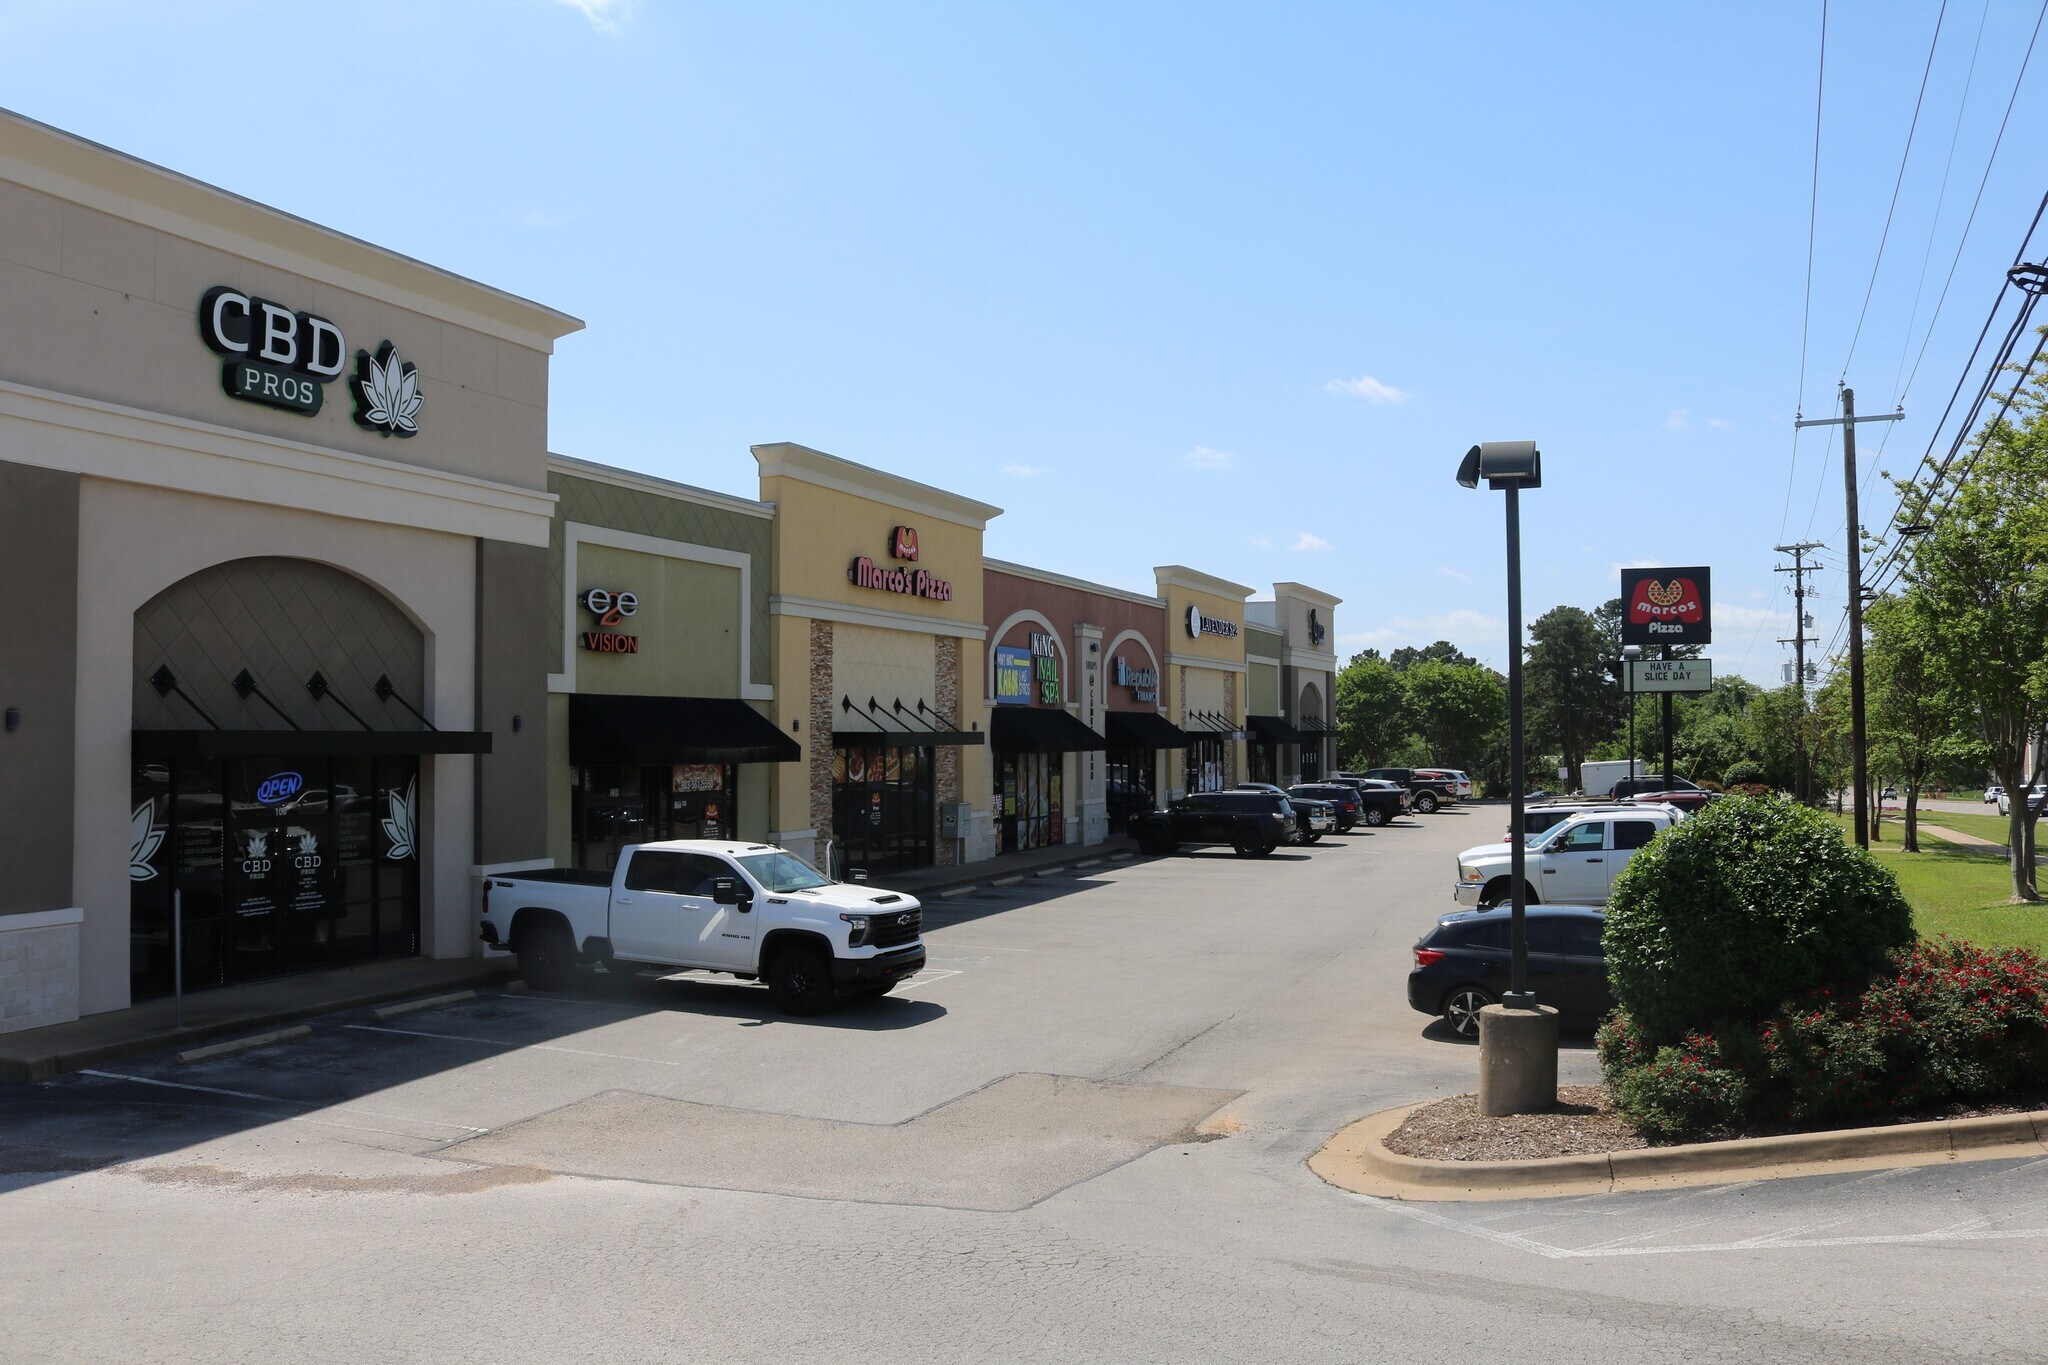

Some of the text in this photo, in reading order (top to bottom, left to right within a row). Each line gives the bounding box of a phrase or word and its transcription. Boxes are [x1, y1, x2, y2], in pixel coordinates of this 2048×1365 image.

[212, 291, 347, 377] CBD
[244, 367, 314, 404] PROS
[857, 556, 952, 601] Marco's Pizza
[1202, 616, 1230, 636] LAVENDER
[1648, 621, 1684, 634] Pizza
[588, 632, 639, 653] VISION
[1038, 657, 1058, 683] NAIL
[1644, 671, 1691, 681] SLICE DAY
[1650, 662, 1686, 671] HAVE A
[1042, 681, 1060, 705] SPA
[259, 776, 298, 798] OPEN
[274, 807, 288, 816] 100
[242, 859, 272, 873] CBD
[294, 855, 322, 869] CBD
